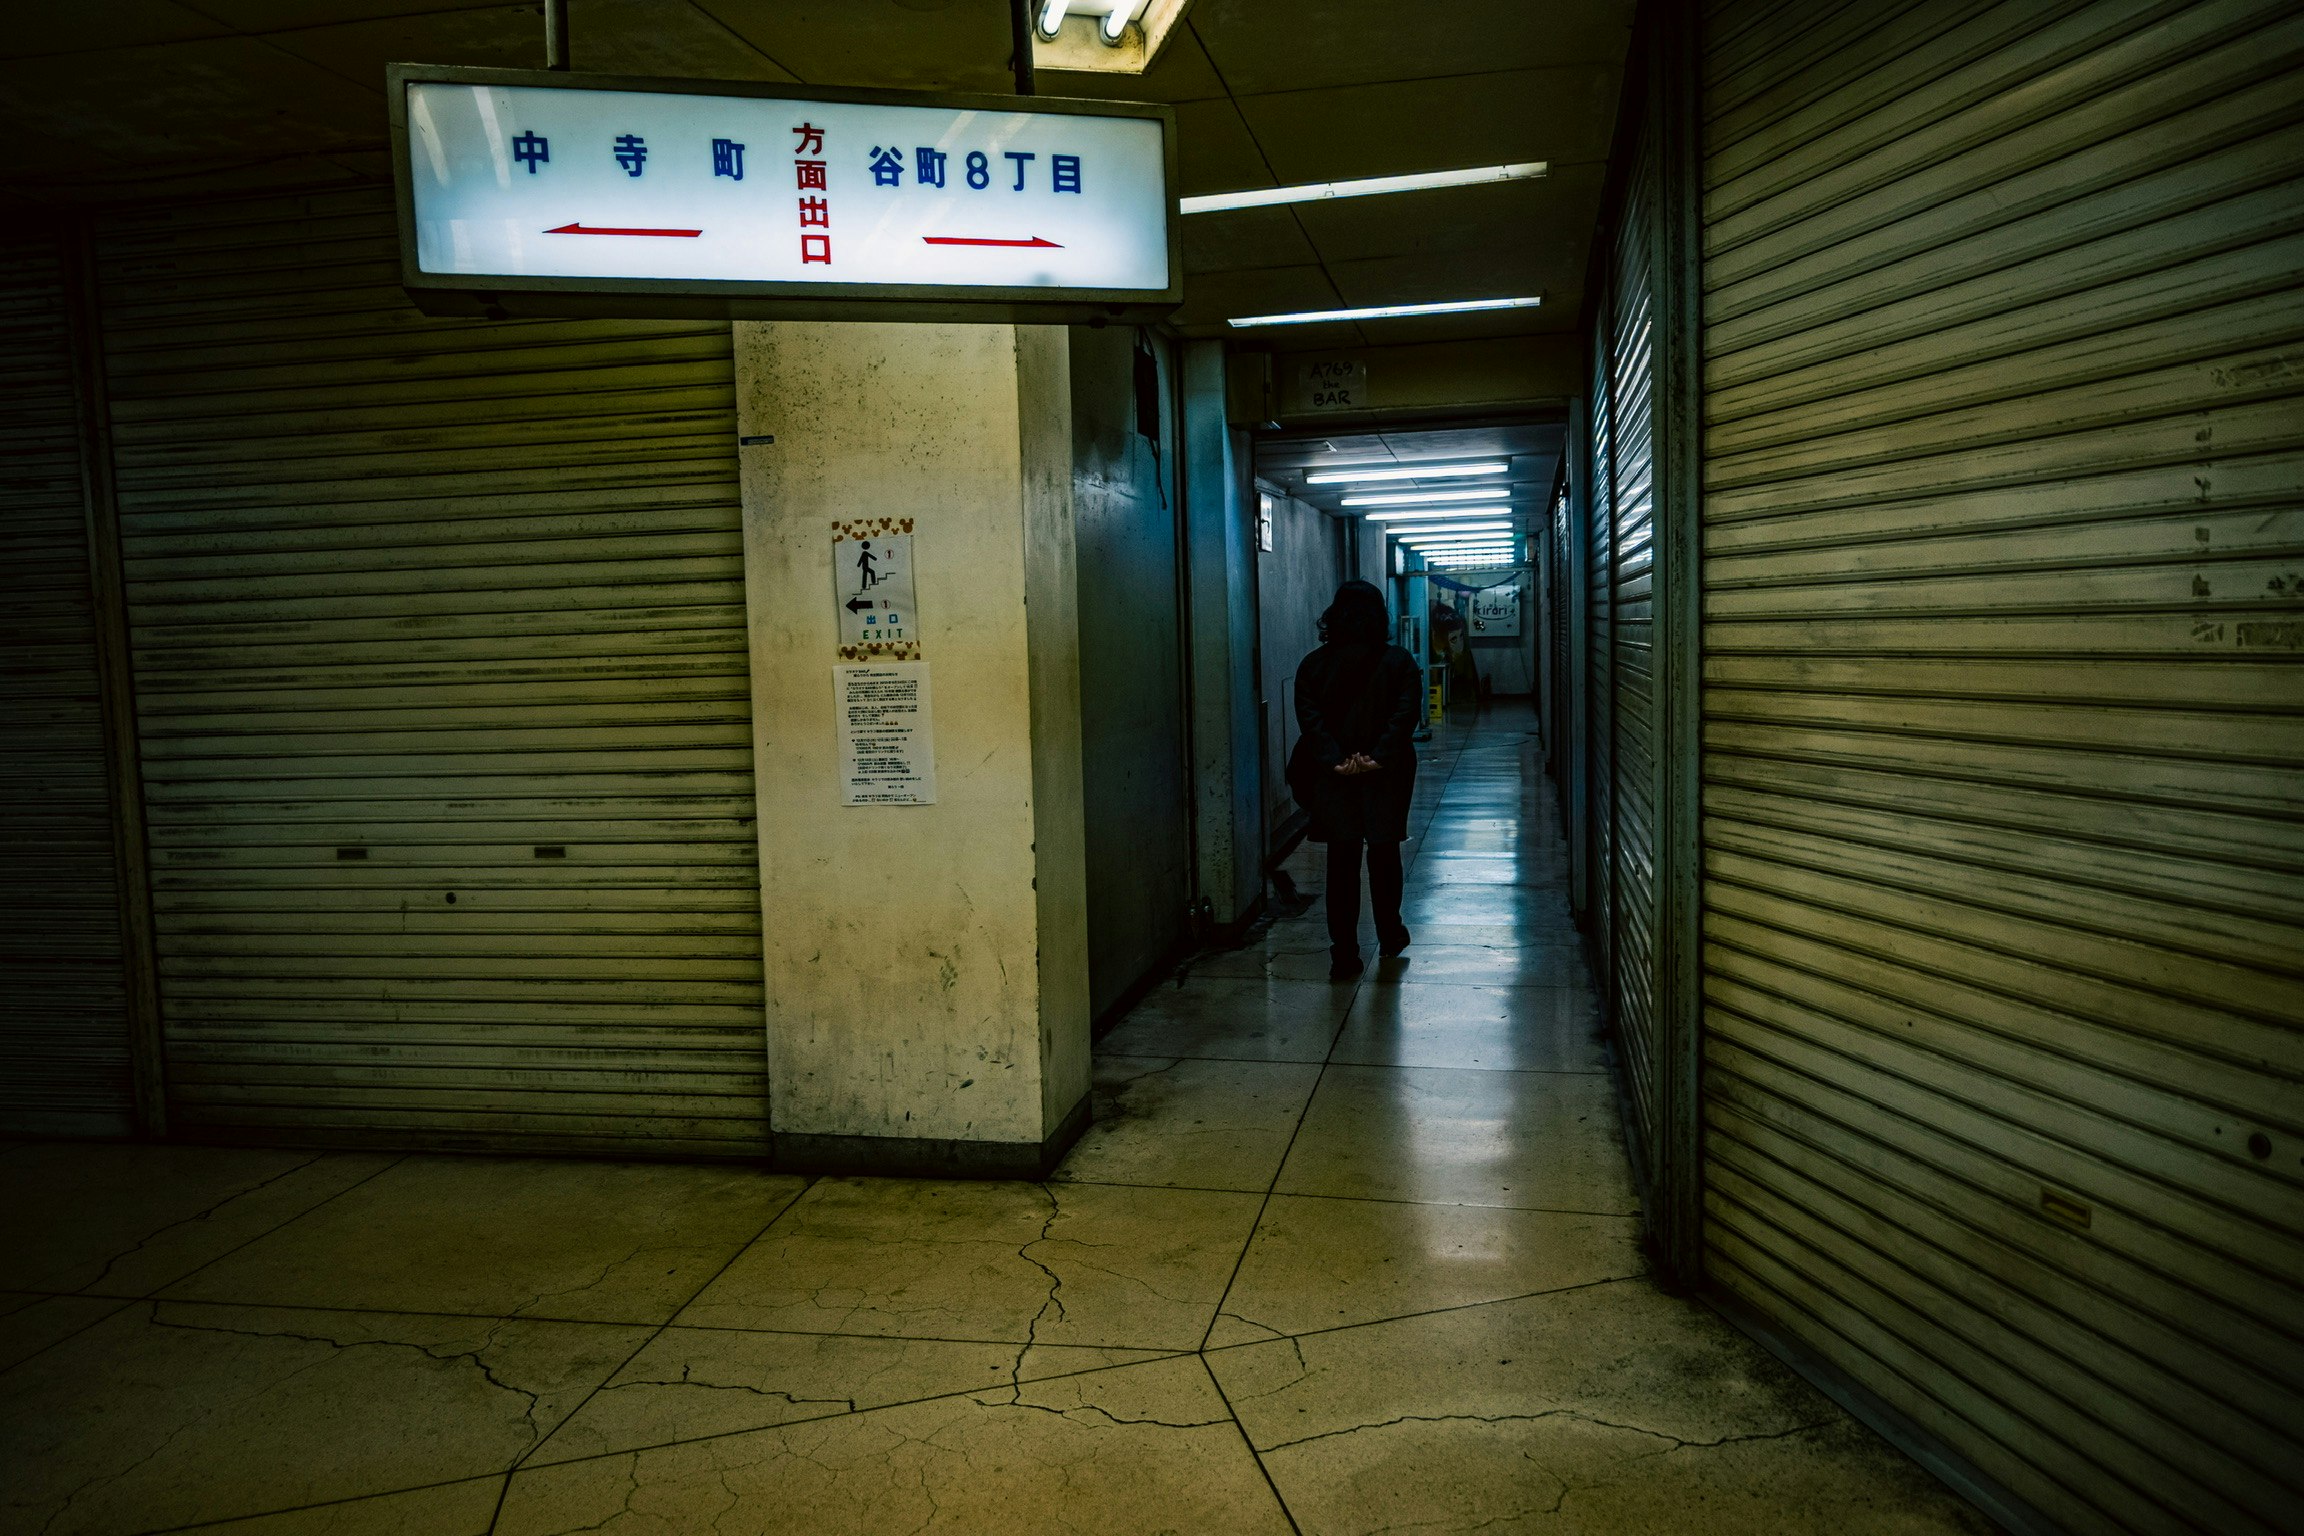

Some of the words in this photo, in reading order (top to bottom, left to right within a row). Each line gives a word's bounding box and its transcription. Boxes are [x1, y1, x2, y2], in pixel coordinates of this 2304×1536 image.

[512, 130, 746, 181] 中寺町
[868, 145, 1083, 194] 谷町8丁目
[793, 122, 832, 265] 方面出口
[1313, 390, 1351, 406] BAR
[863, 629, 903, 639] EXIT
[866, 614, 898, 624] 出口
